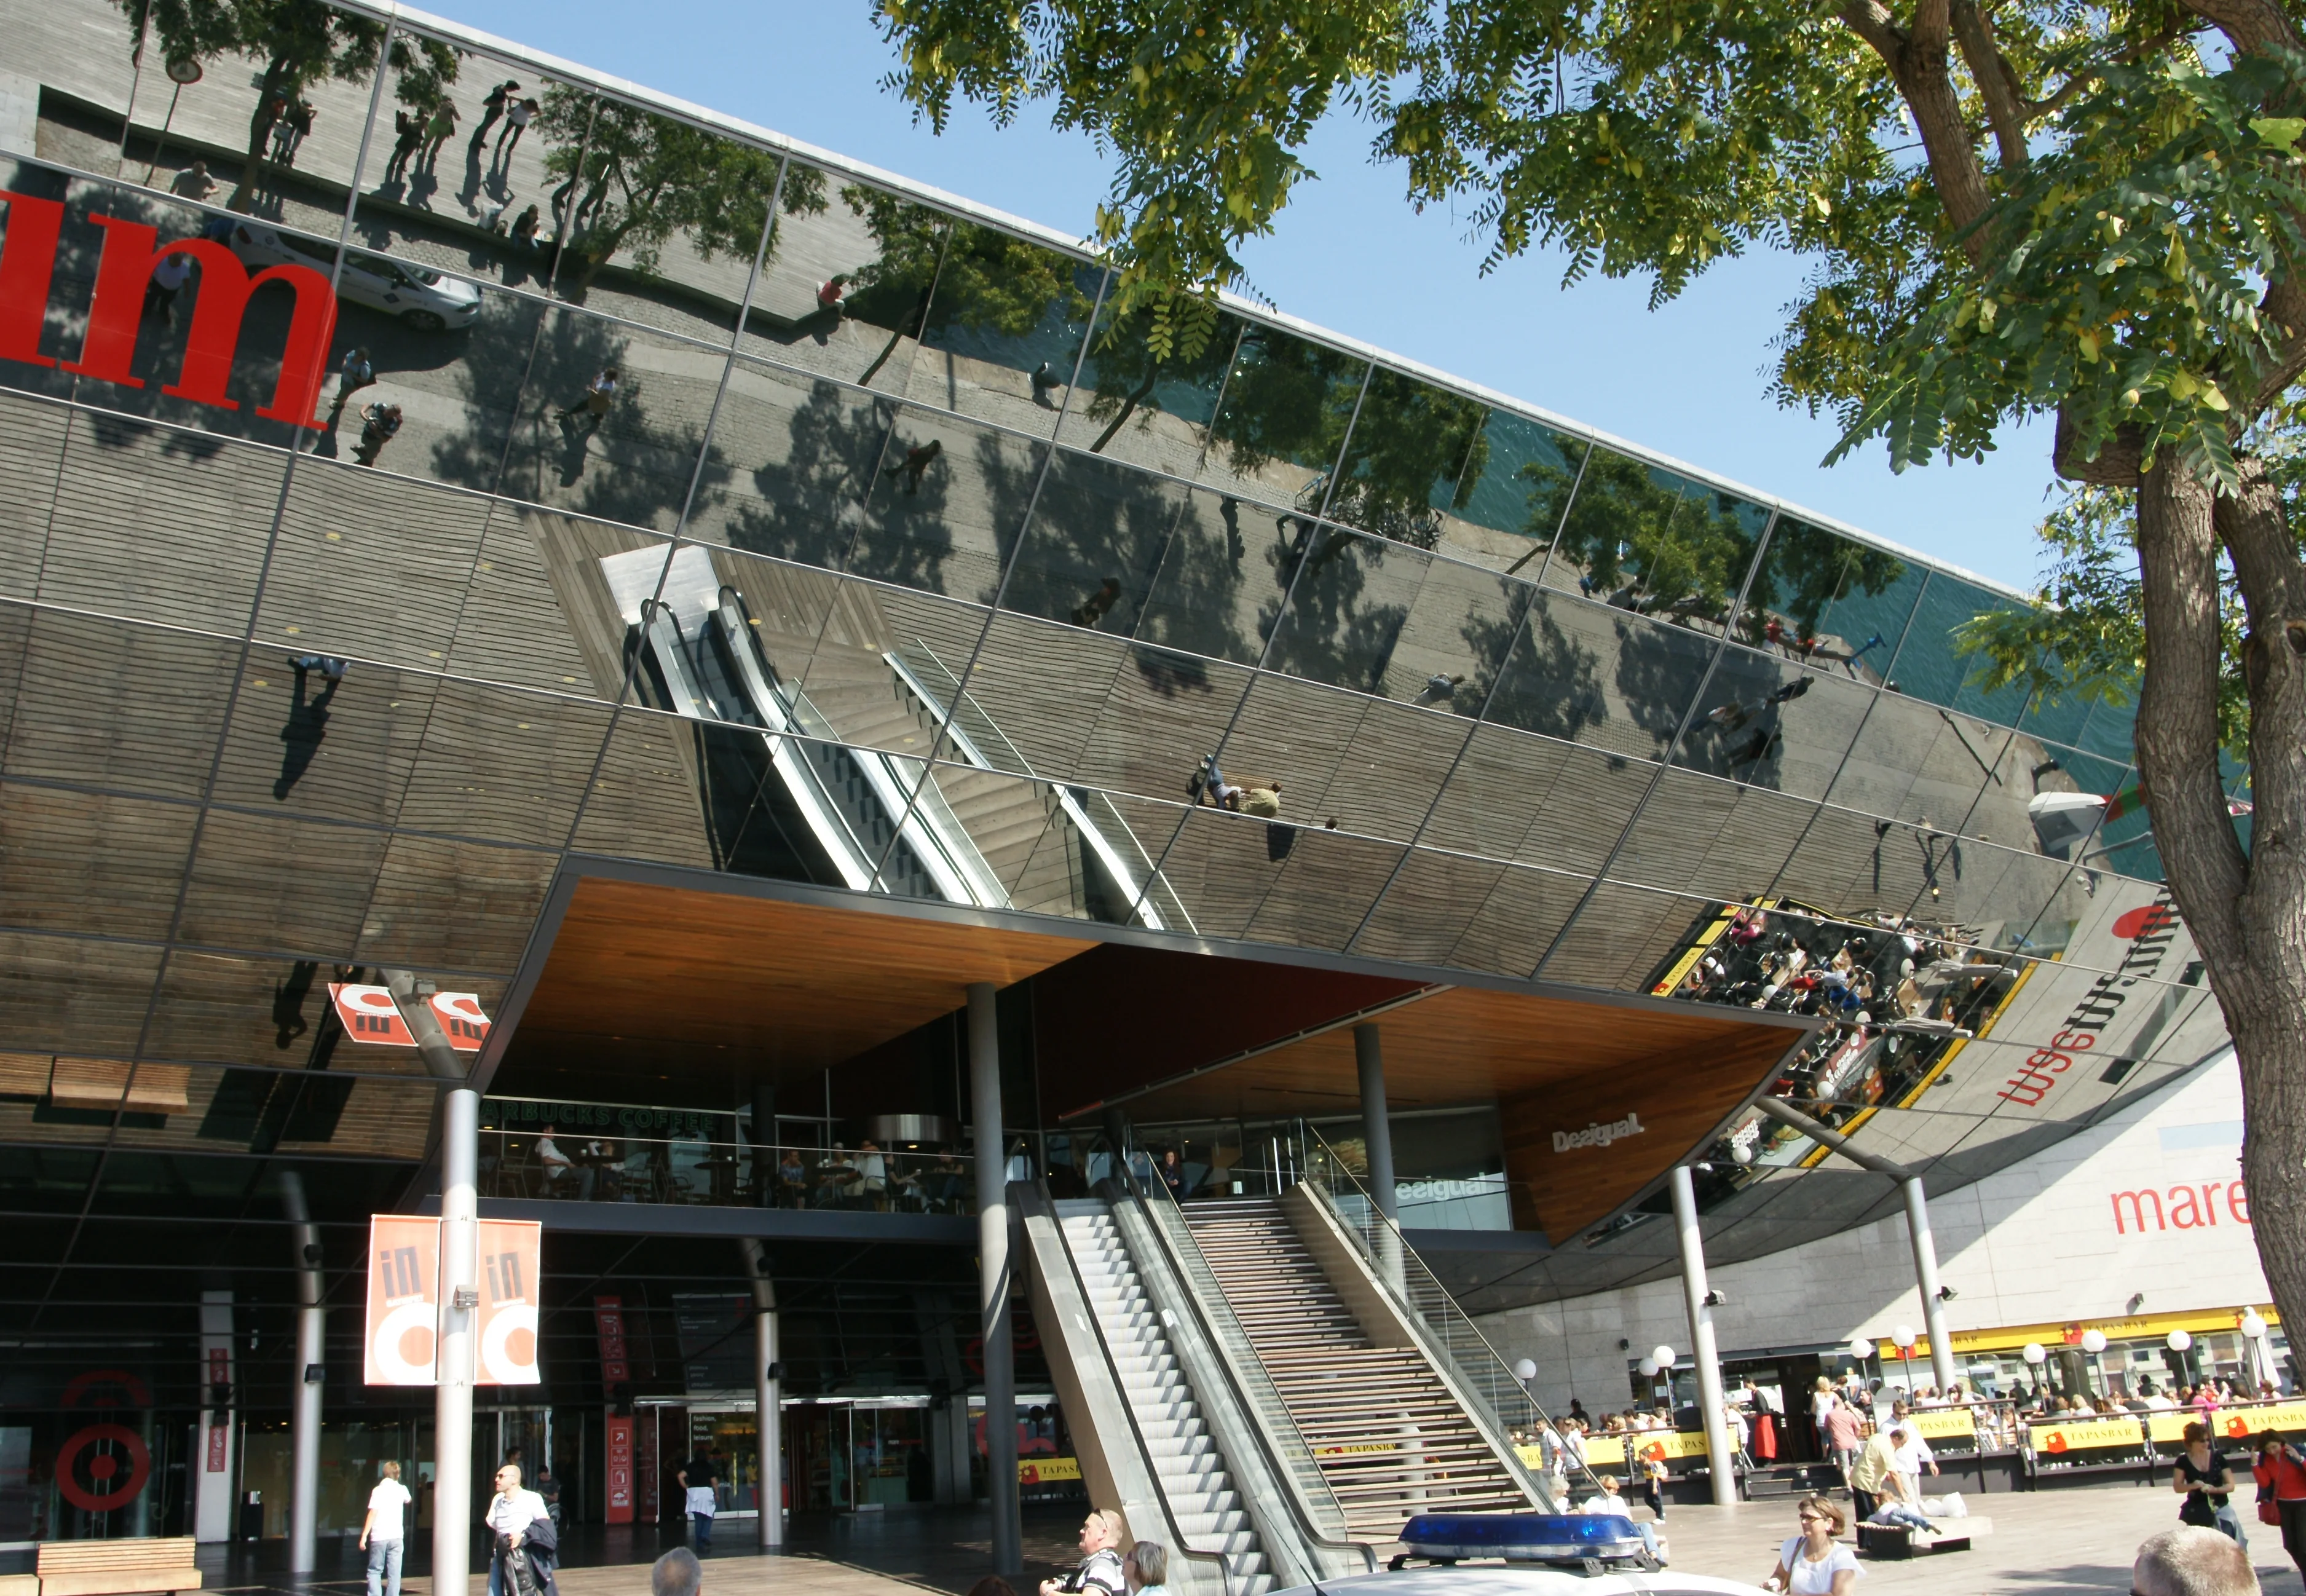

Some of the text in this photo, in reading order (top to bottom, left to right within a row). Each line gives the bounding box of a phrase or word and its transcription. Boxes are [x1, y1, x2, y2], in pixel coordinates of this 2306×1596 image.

[617, 1108, 714, 1131] COFFEE
[380, 1246, 422, 1299] in
[486, 1251, 524, 1303] in
[2069, 1428, 2133, 1440] TAPASBAR
